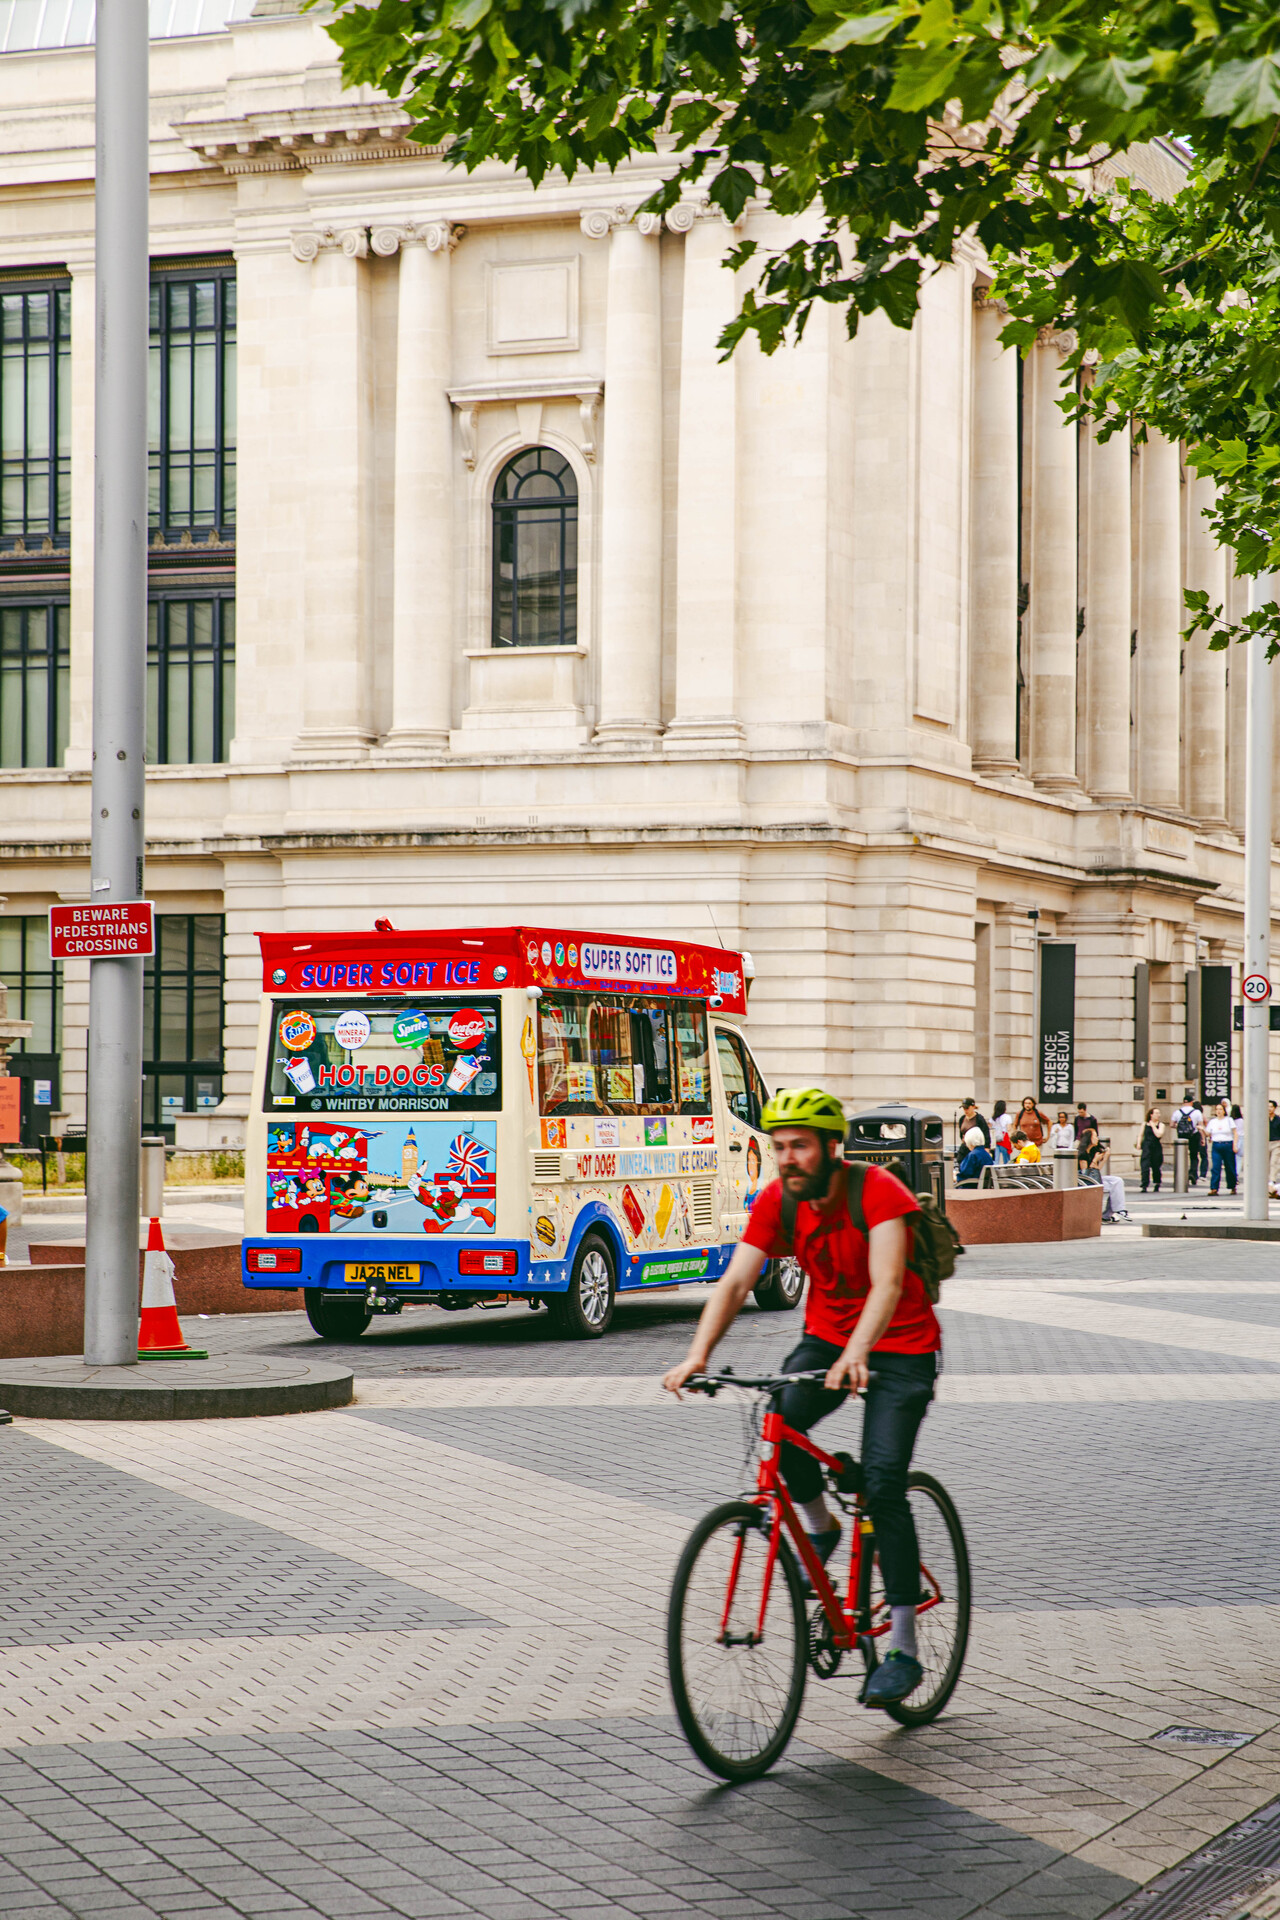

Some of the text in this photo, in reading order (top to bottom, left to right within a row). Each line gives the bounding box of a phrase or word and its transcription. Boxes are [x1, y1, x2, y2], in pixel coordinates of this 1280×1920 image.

[73, 908, 129, 922] BEWARE
[54, 922, 148, 938] PEDESTRIANS
[65, 938, 138, 953] CROSSING
[584, 948, 622, 972] SUPER
[625, 951, 652, 975] SOFT
[656, 954, 673, 977] ICE
[300, 961, 481, 987] SUPER SOFT ICE
[1246, 982, 1265, 994] 20
[285, 1022, 310, 1041] Fanta
[337, 1029, 367, 1037] MINERAL
[396, 1020, 428, 1038] Sprite
[341, 1036, 363, 1044] WATER
[1043, 1034, 1057, 1094] SCIENCE
[1056, 1031, 1070, 1094] MUSEUM
[1204, 1045, 1216, 1097] SCIENCE
[1216, 1041, 1228, 1097] MUSEUM
[318, 1063, 369, 1087] HOT
[374, 1063, 445, 1087] DOGS
[326, 1098, 449, 1110] WHITBY MORRISON
[577, 1149, 718, 1178] HOT DOGS MINERAL WATER ICE CREAMS
[351, 1266, 414, 1280] JA26 NEL
